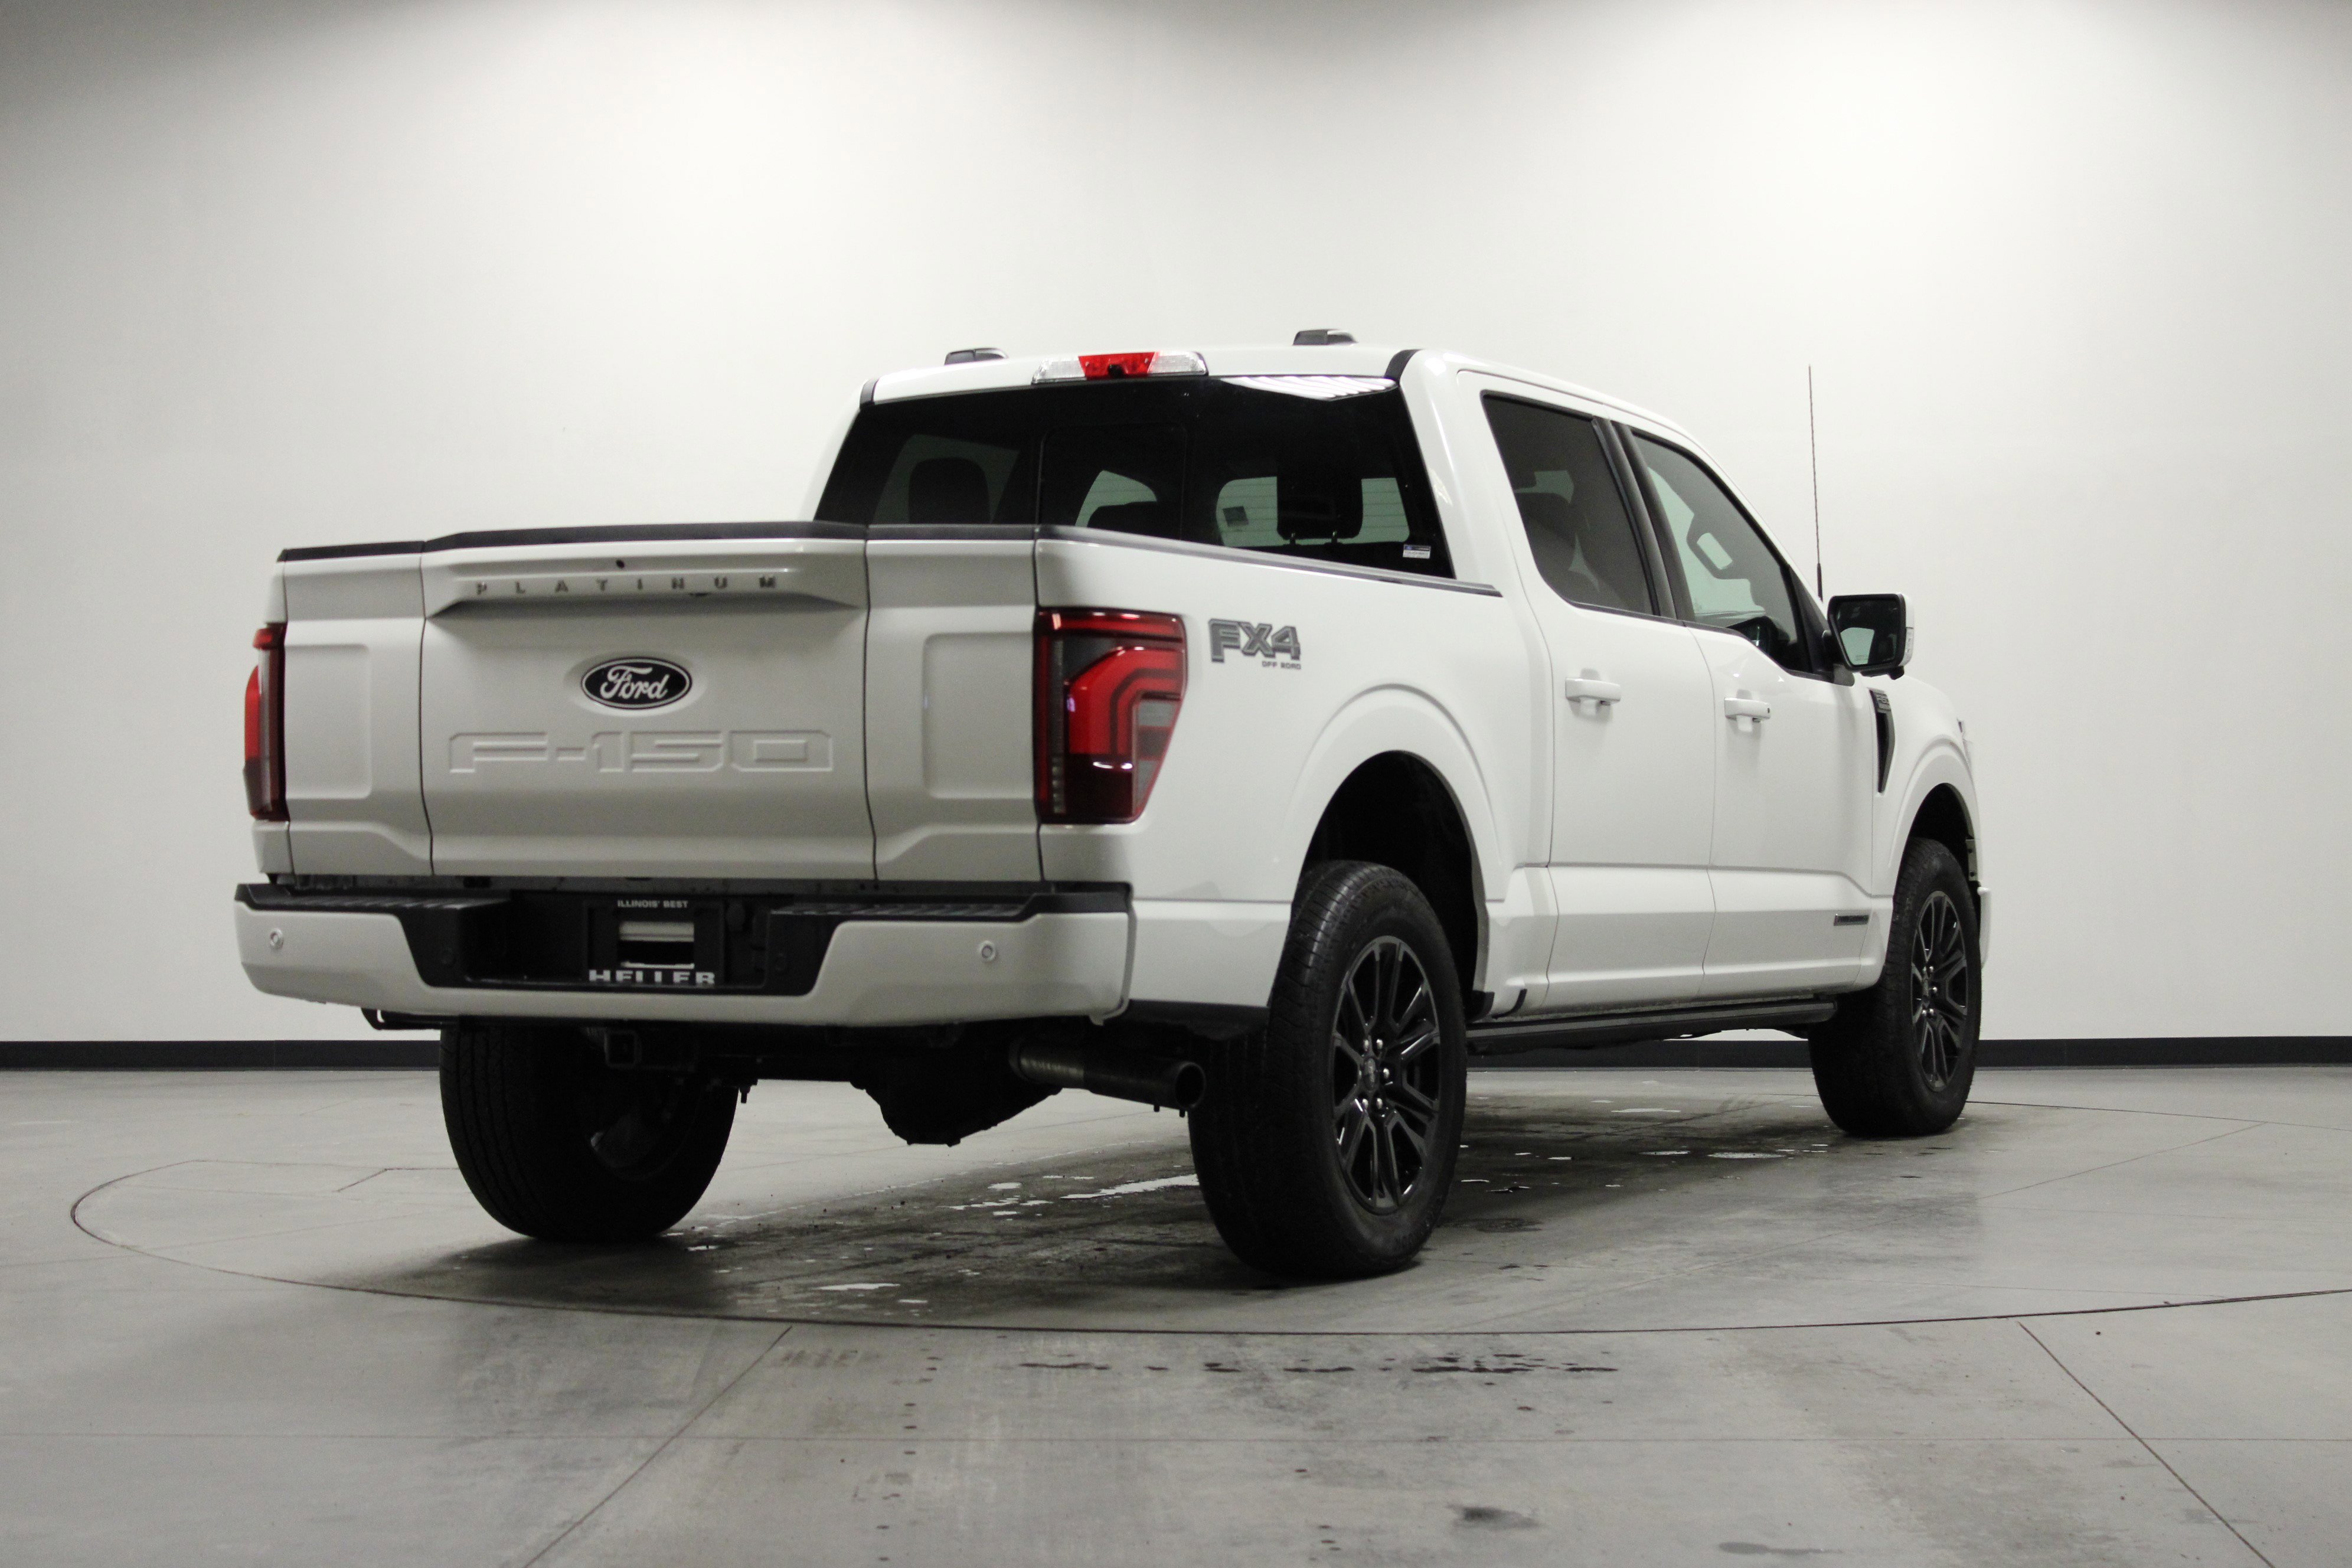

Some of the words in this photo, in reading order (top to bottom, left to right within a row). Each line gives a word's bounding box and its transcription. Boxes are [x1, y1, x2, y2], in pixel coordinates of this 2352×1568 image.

[475, 574, 778, 595] PLATINUM
[1208, 618, 1301, 663] FX4
[1262, 660, 1278, 668] OFF
[599, 664, 669, 700] Ford
[449, 730, 834, 773] F-150
[663, 900, 689, 909] BEST
